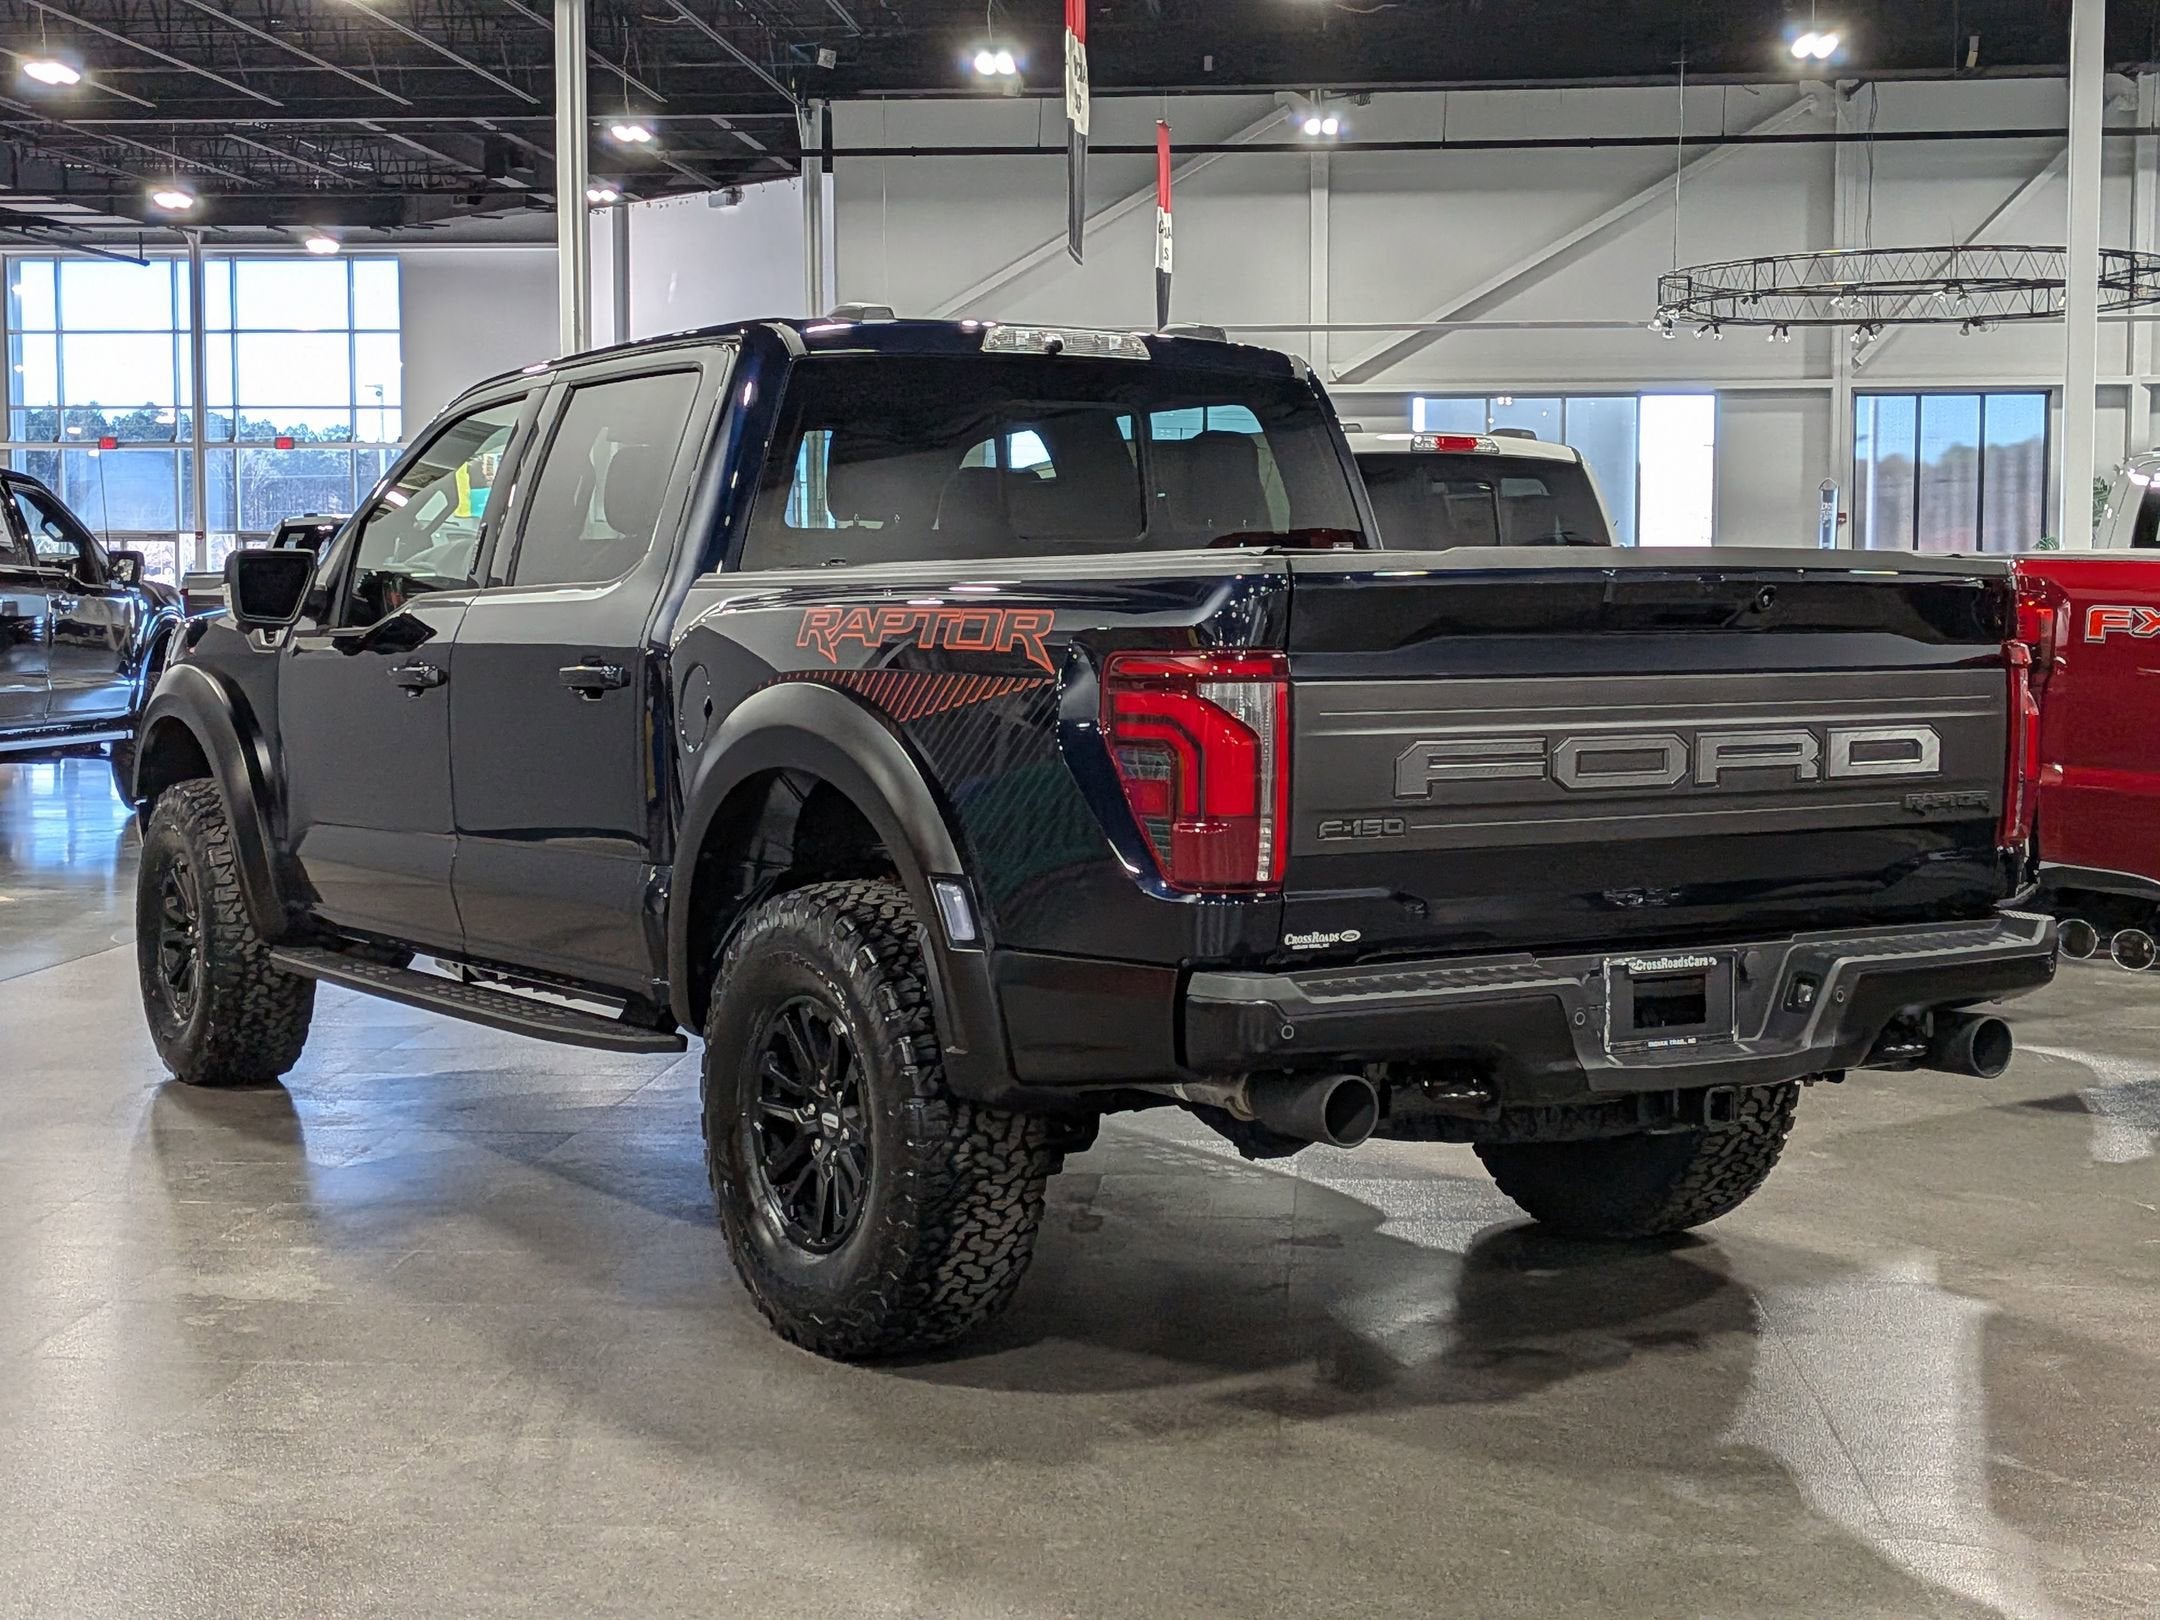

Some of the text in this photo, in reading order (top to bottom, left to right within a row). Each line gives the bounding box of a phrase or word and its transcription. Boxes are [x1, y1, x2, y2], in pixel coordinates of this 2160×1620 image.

[796, 607, 1055, 675] RAPTOR
[1393, 724, 1943, 799] FORD
[1318, 818, 1406, 840] F-150
